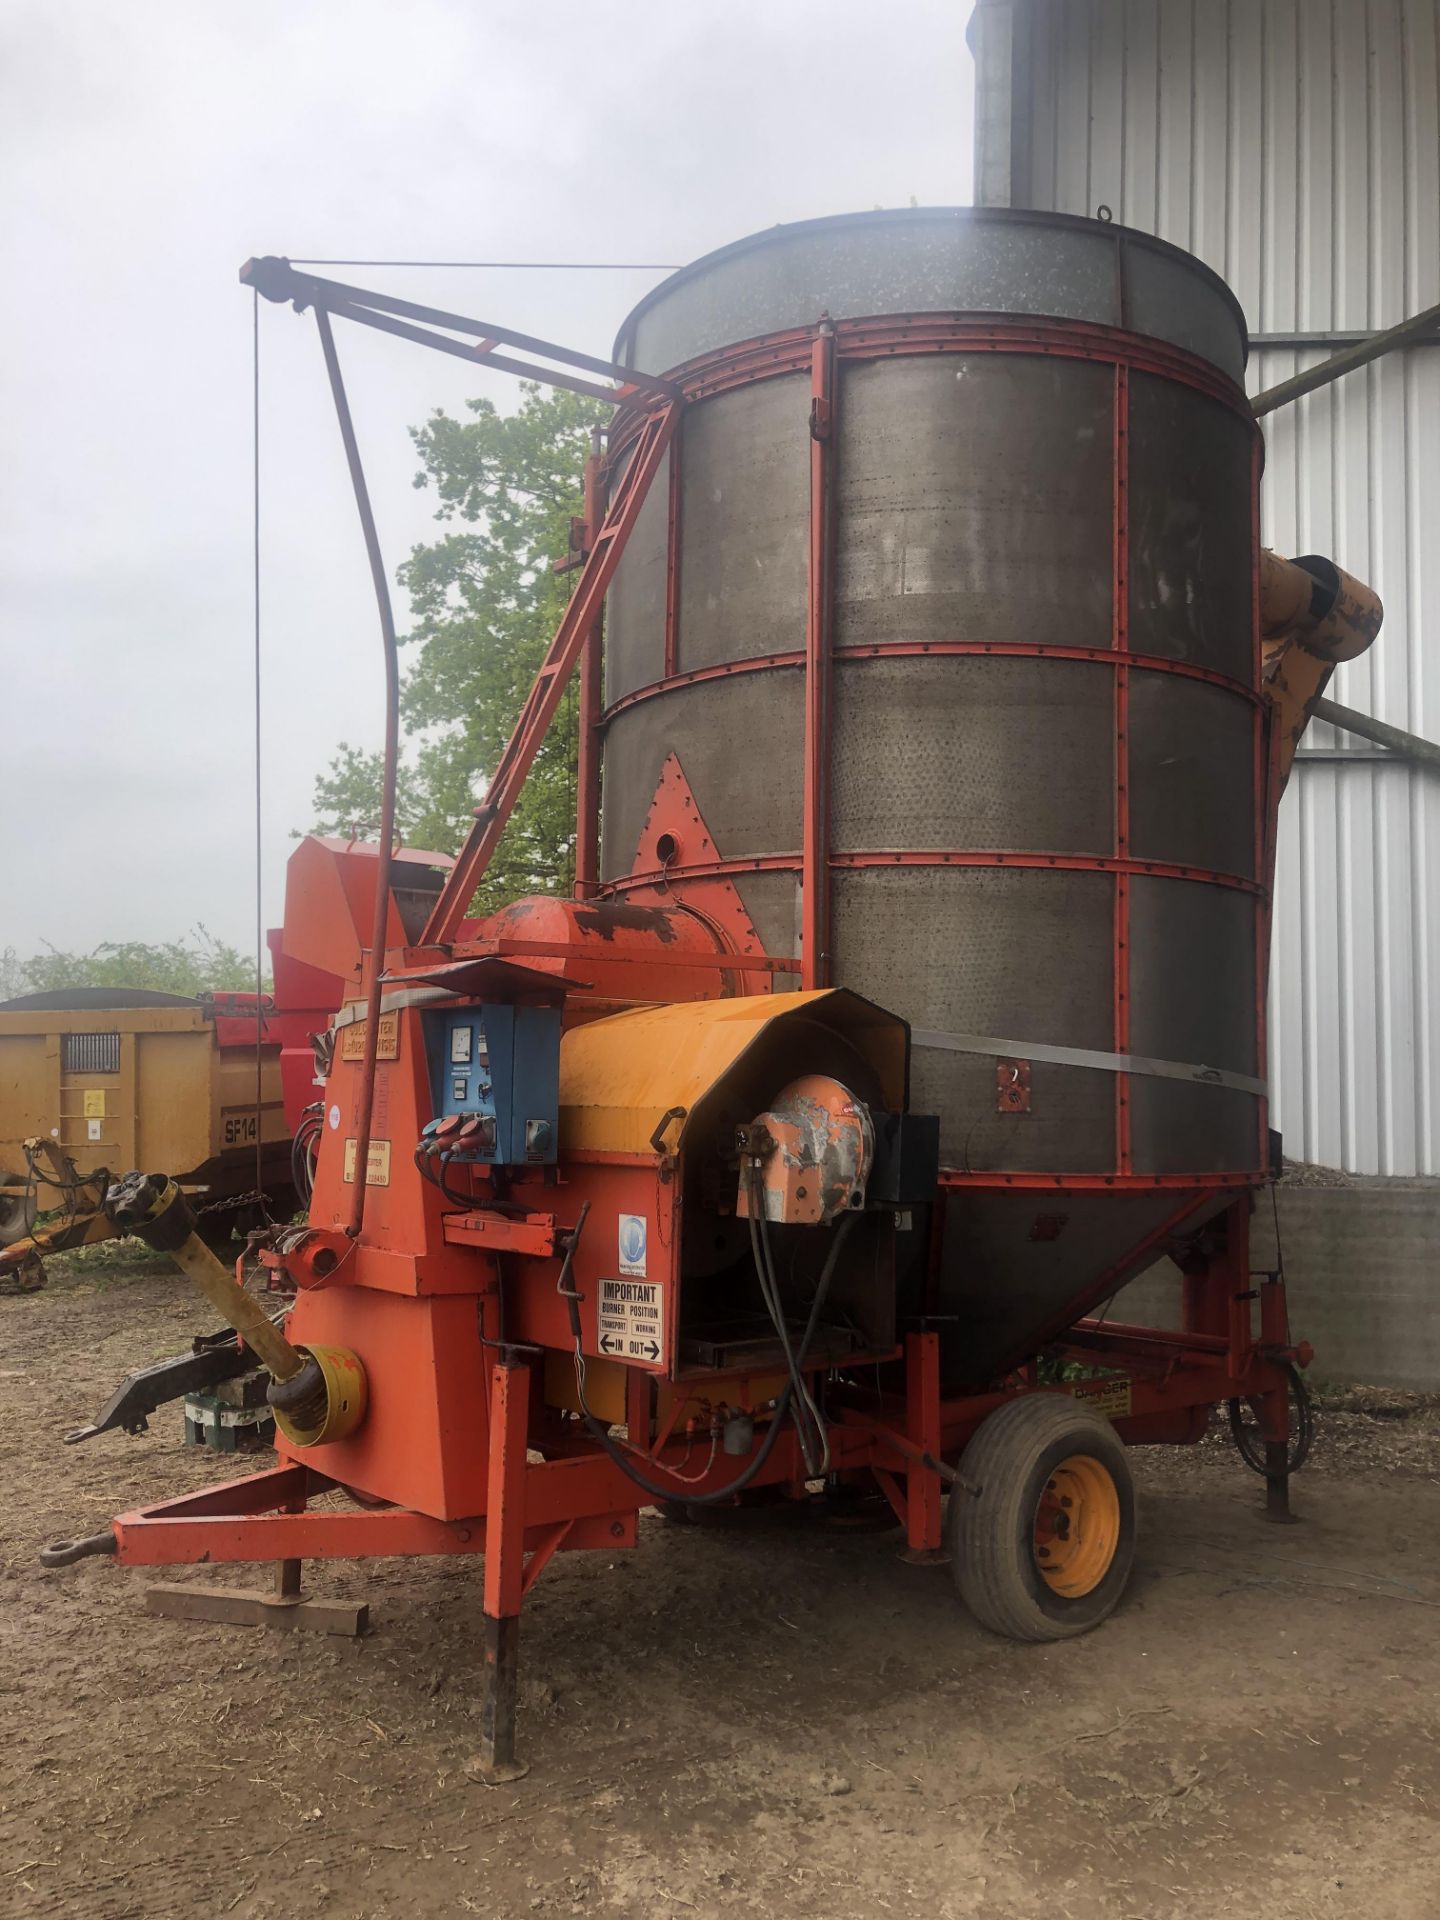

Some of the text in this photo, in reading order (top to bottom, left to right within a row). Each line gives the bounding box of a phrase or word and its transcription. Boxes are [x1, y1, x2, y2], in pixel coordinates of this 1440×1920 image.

[225, 1118, 256, 1143] SF14
[604, 1281, 656, 1303] IMPORTANT
[602, 1302, 658, 1319] BURNER POSITION
[601, 1319, 626, 1331] TRANSPORT
[635, 1323, 656, 1334] WORKING
[615, 1338, 645, 1355] IN OUT
